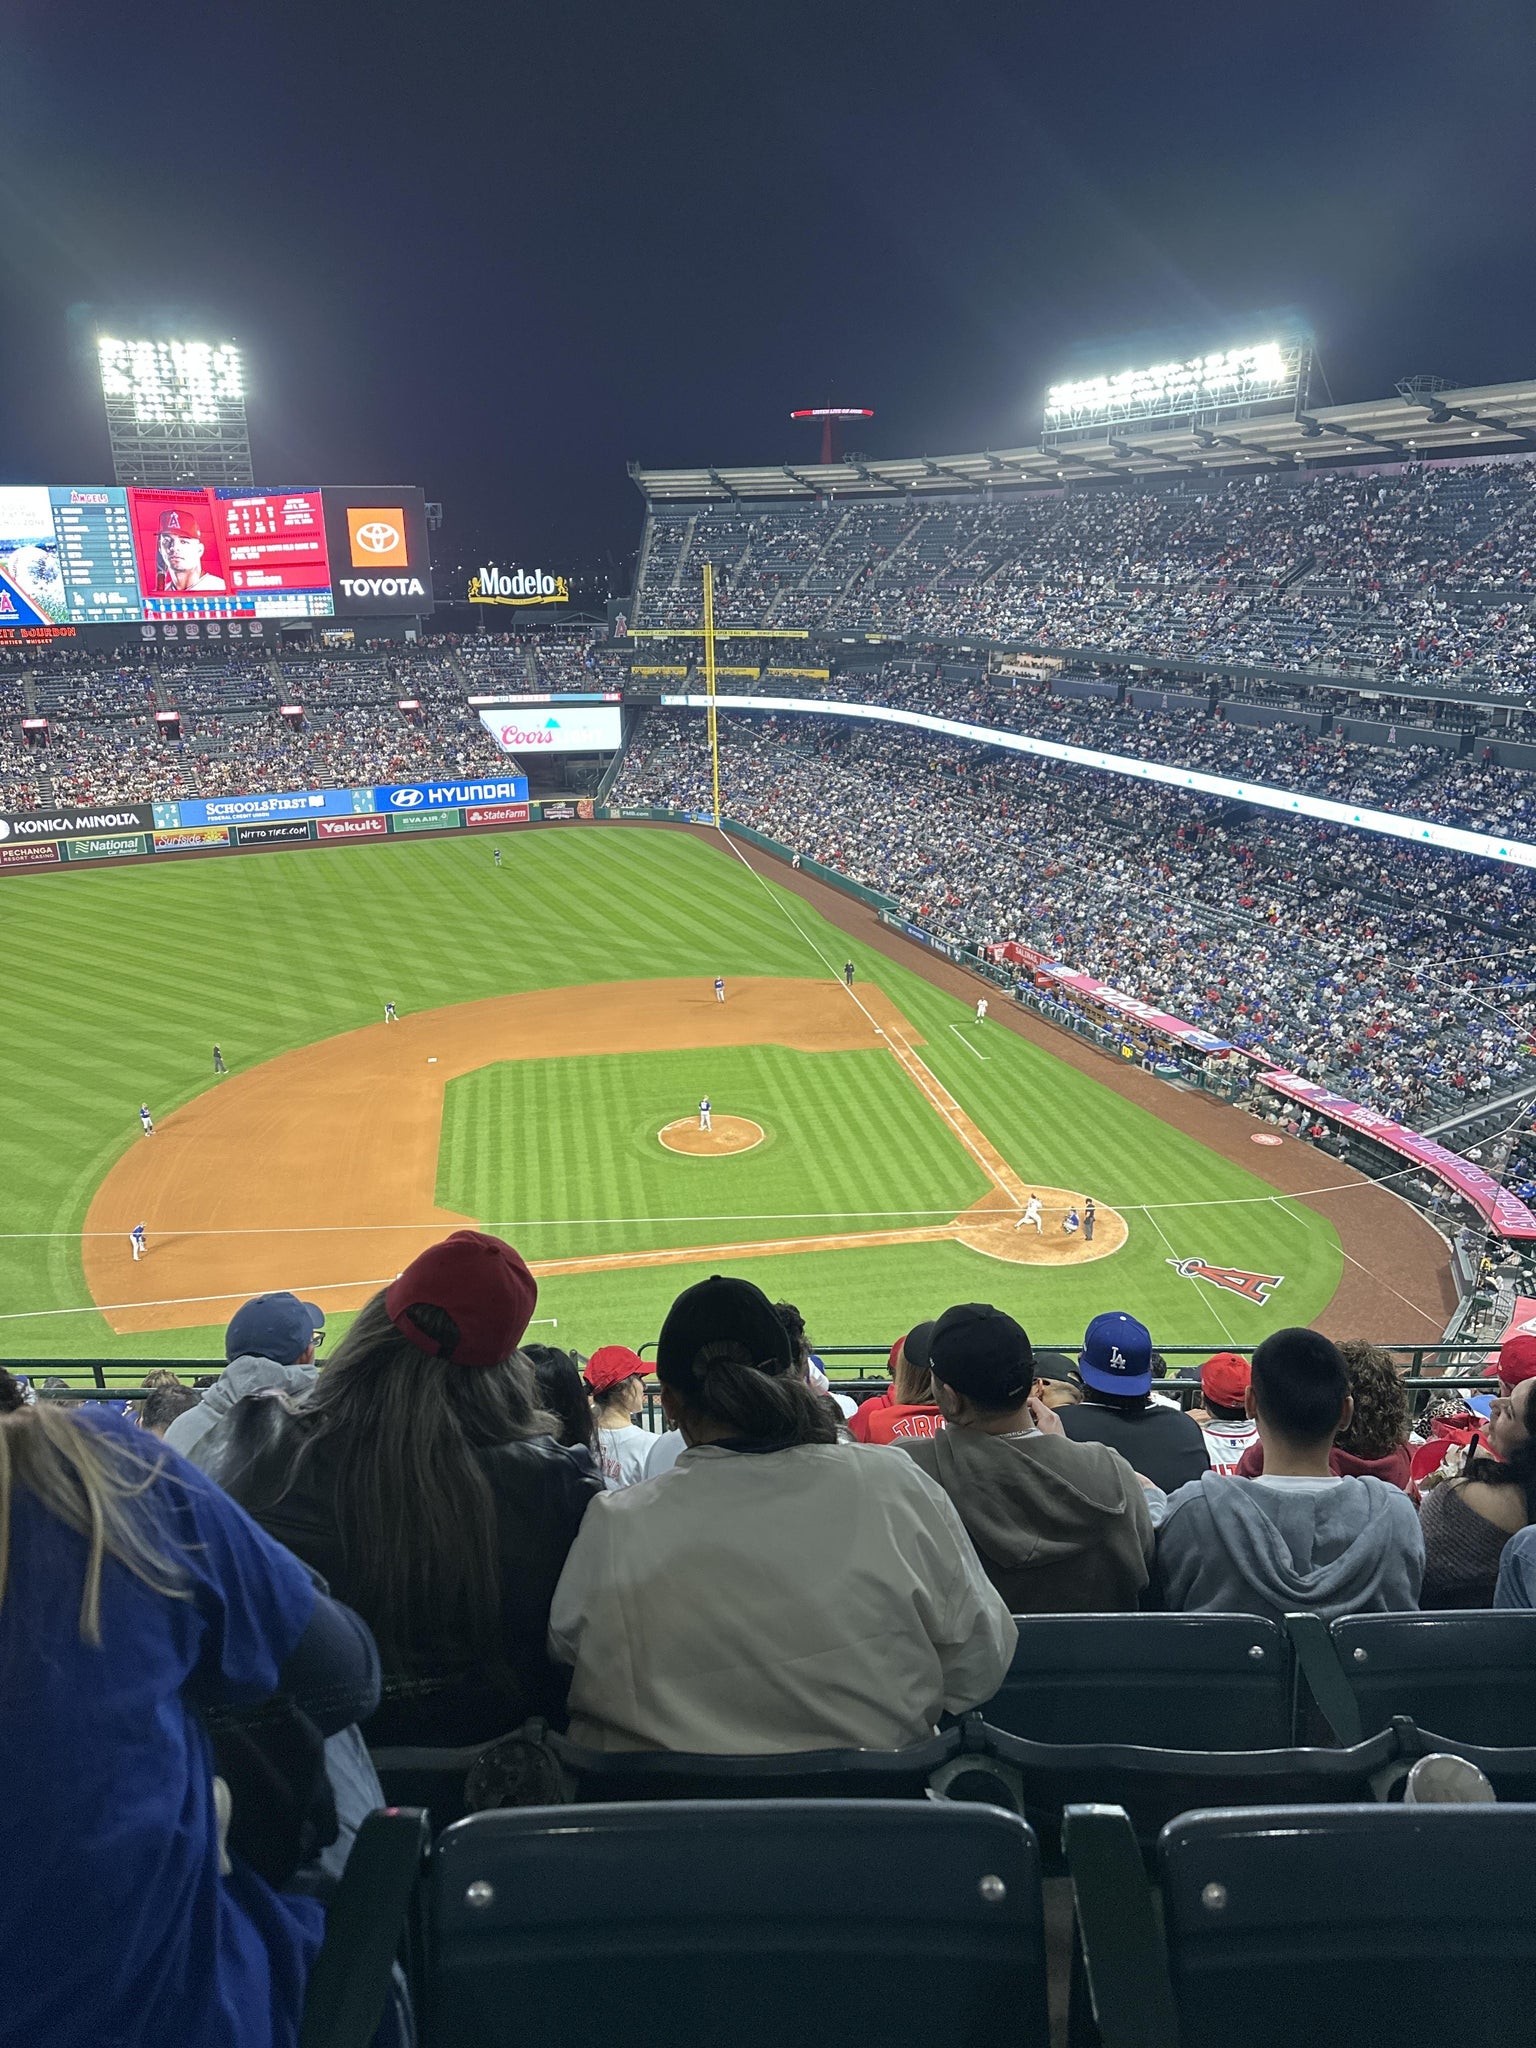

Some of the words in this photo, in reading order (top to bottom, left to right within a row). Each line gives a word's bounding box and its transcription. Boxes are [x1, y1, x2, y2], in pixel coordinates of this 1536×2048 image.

[340, 578, 425, 597] TOYOTA
[479, 567, 555, 596] Modelo
[501, 725, 553, 745] Coors
[428, 783, 515, 804] HYUNDAI
[14, 818, 74, 834] KONICA
[76, 813, 140, 829] MINOLTA
[240, 831, 266, 839] NITTO
[267, 826, 307, 837] TIRE.COM
[321, 819, 380, 834] Yakult
[90, 838, 138, 852] National
[159, 834, 201, 847] Surfside
[2, 846, 53, 857] PECHANGA
[1109, 1346, 1126, 1369] LA
